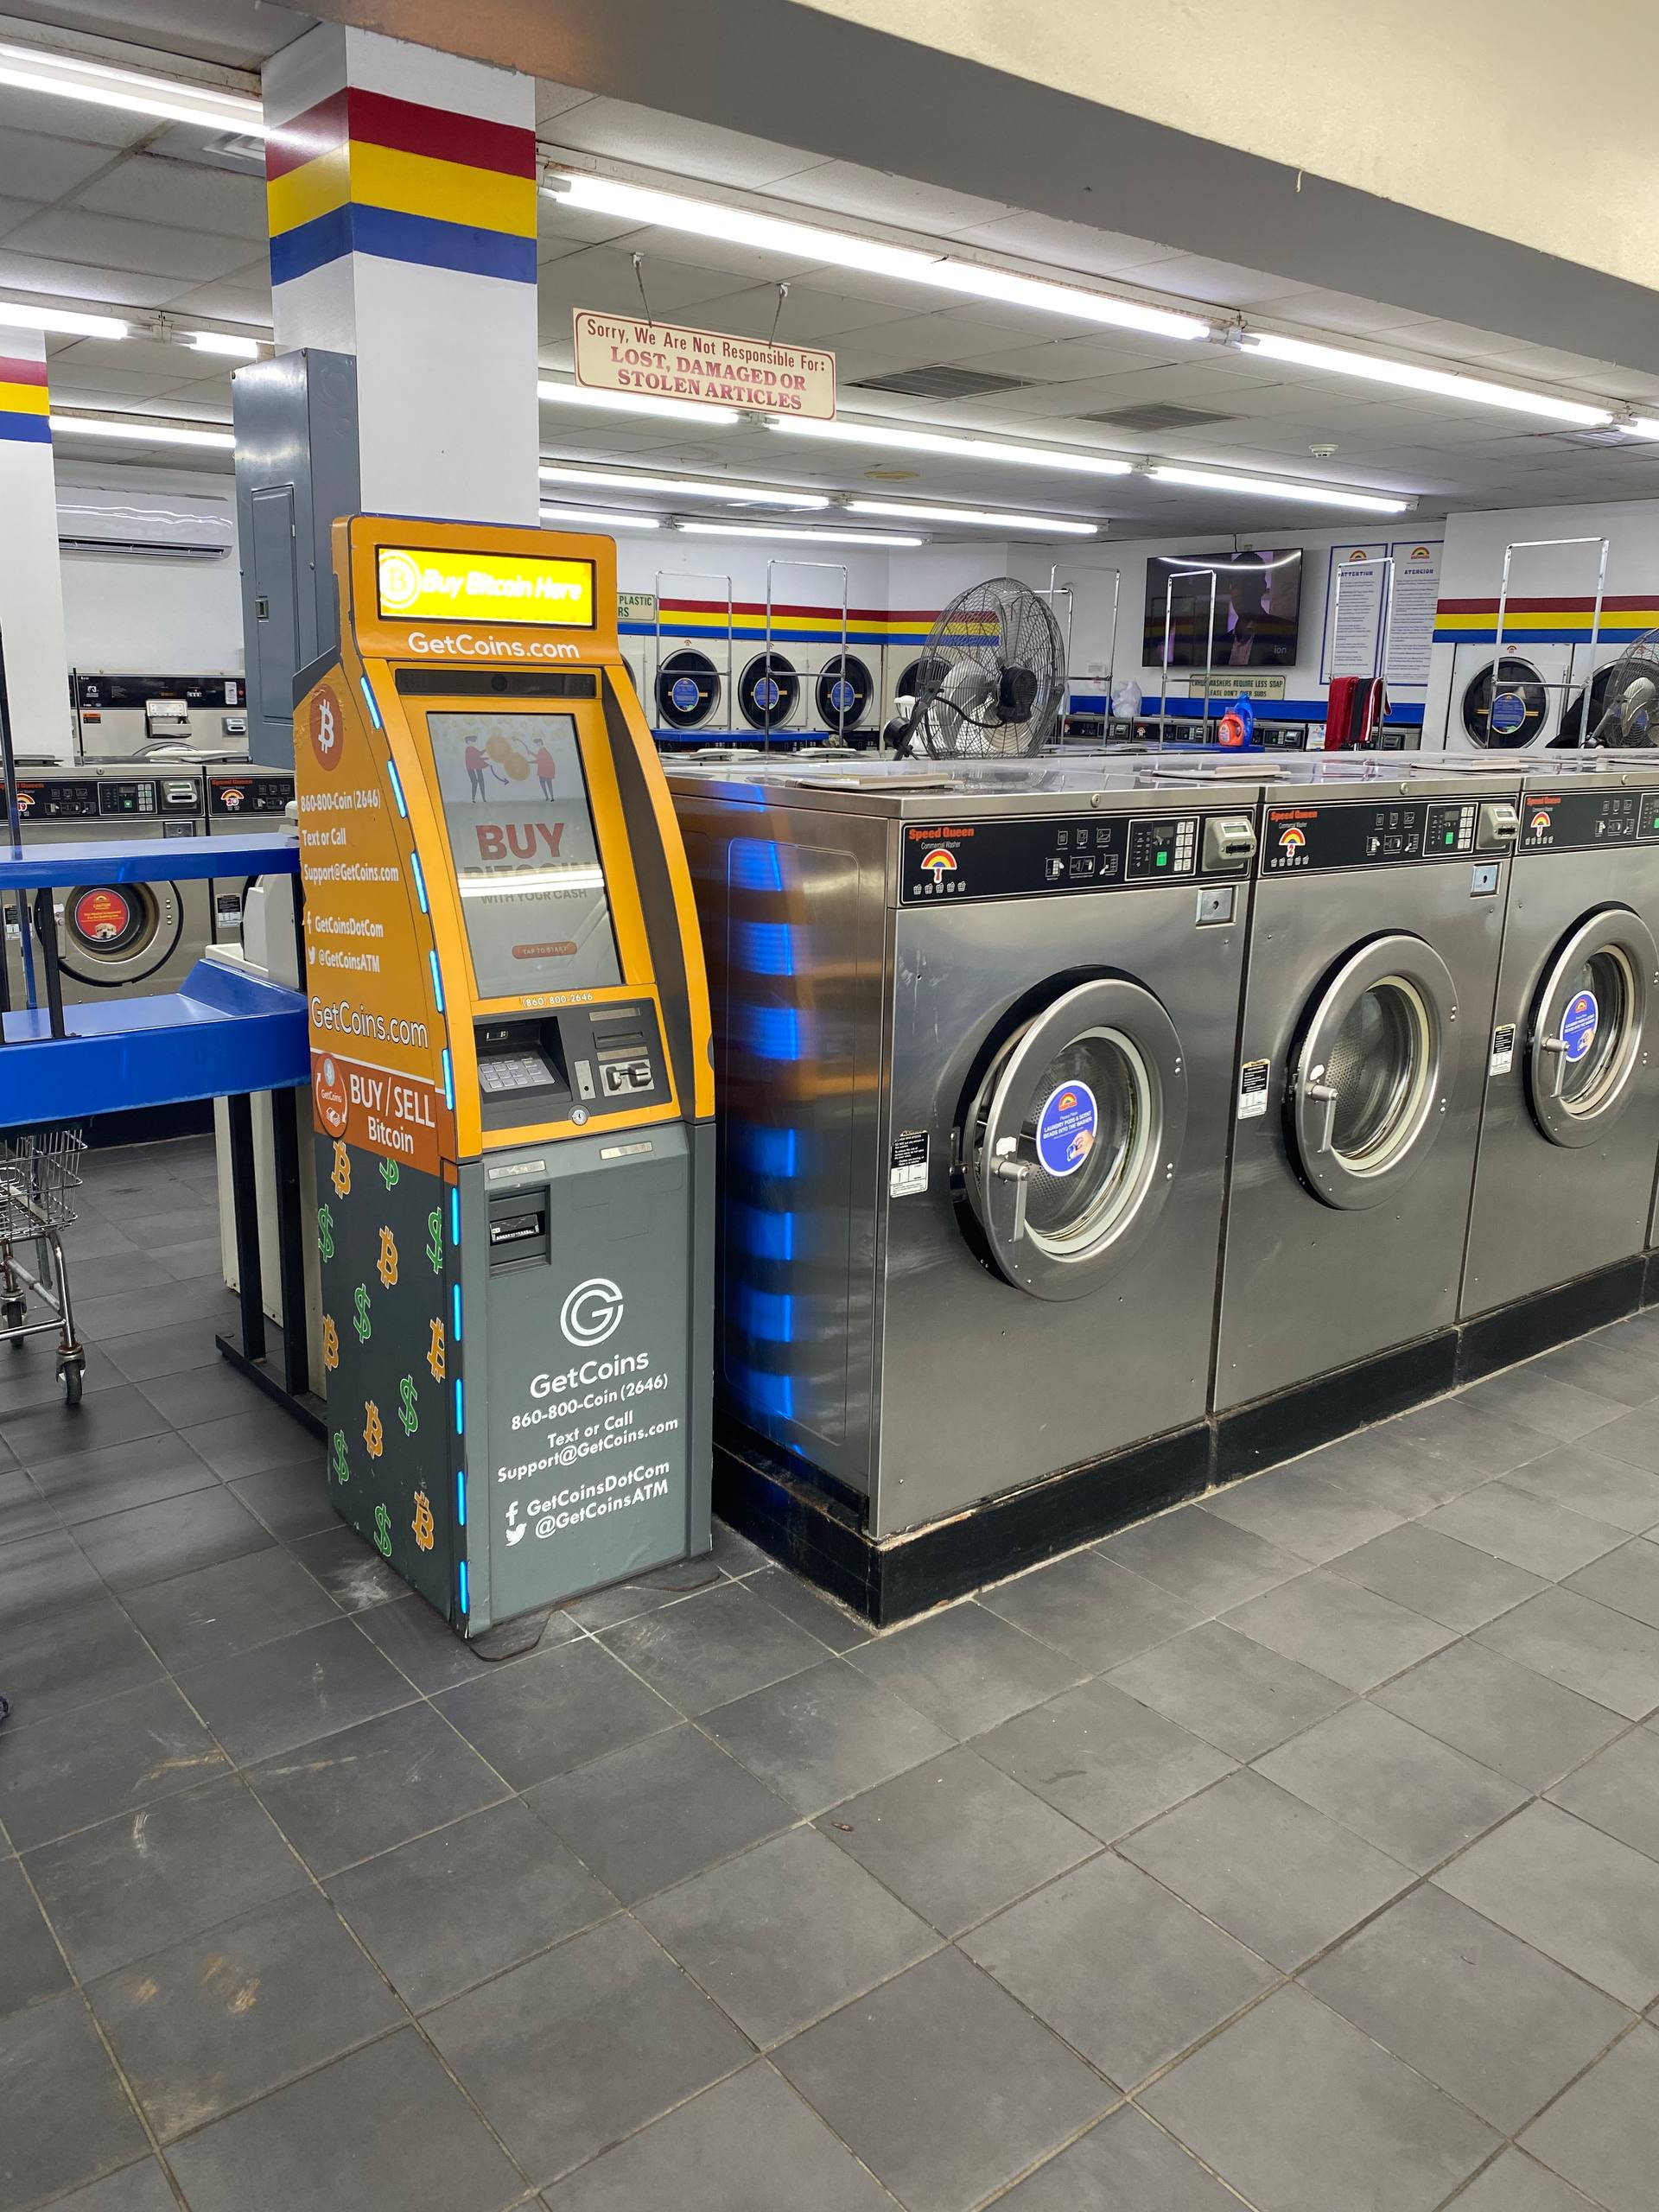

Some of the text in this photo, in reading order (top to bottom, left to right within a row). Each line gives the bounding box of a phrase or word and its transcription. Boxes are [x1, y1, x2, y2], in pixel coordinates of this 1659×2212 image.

[588, 319, 824, 372] Sorry, We Are Not Responsible For:
[610, 346, 806, 391] LOST, DAMAGED OR
[618, 369, 802, 410] STOLEN ARTICLES
[422, 569, 582, 601] Buy Bitcoin Here
[620, 596, 652, 606] PLASTIC
[618, 607, 629, 617] RS
[408, 632, 580, 658] GetCoins.com
[301, 788, 380, 812] 860-800-Coin (2646)
[302, 828, 346, 846] Text or Call
[475, 823, 564, 861] BUY
[909, 827, 974, 841] Speed Queen
[304, 863, 398, 885] Support@GetCoins.com
[481, 889, 588, 904] WITH YOUR CASH
[315, 916, 384, 938] GetCoinsDotCom
[318, 950, 380, 973] @GetCoinsATM
[522, 993, 593, 1007] (860) 800-2646
[311, 996, 429, 1048] GetCoins.com
[321, 1089, 342, 1103] GetCoins
[367, 1116, 414, 1154] Bitcoin
[530, 1351, 650, 1399] GetCoins
[511, 1373, 669, 1431] 860-800-Coin (2646)
[547, 1410, 632, 1448] Text or Call
[497, 1417, 678, 1483] Support@GetCoins.com
[526, 1462, 670, 1516] GetCoinsDotCom
[535, 1479, 669, 1539] @GetCoinsATM
